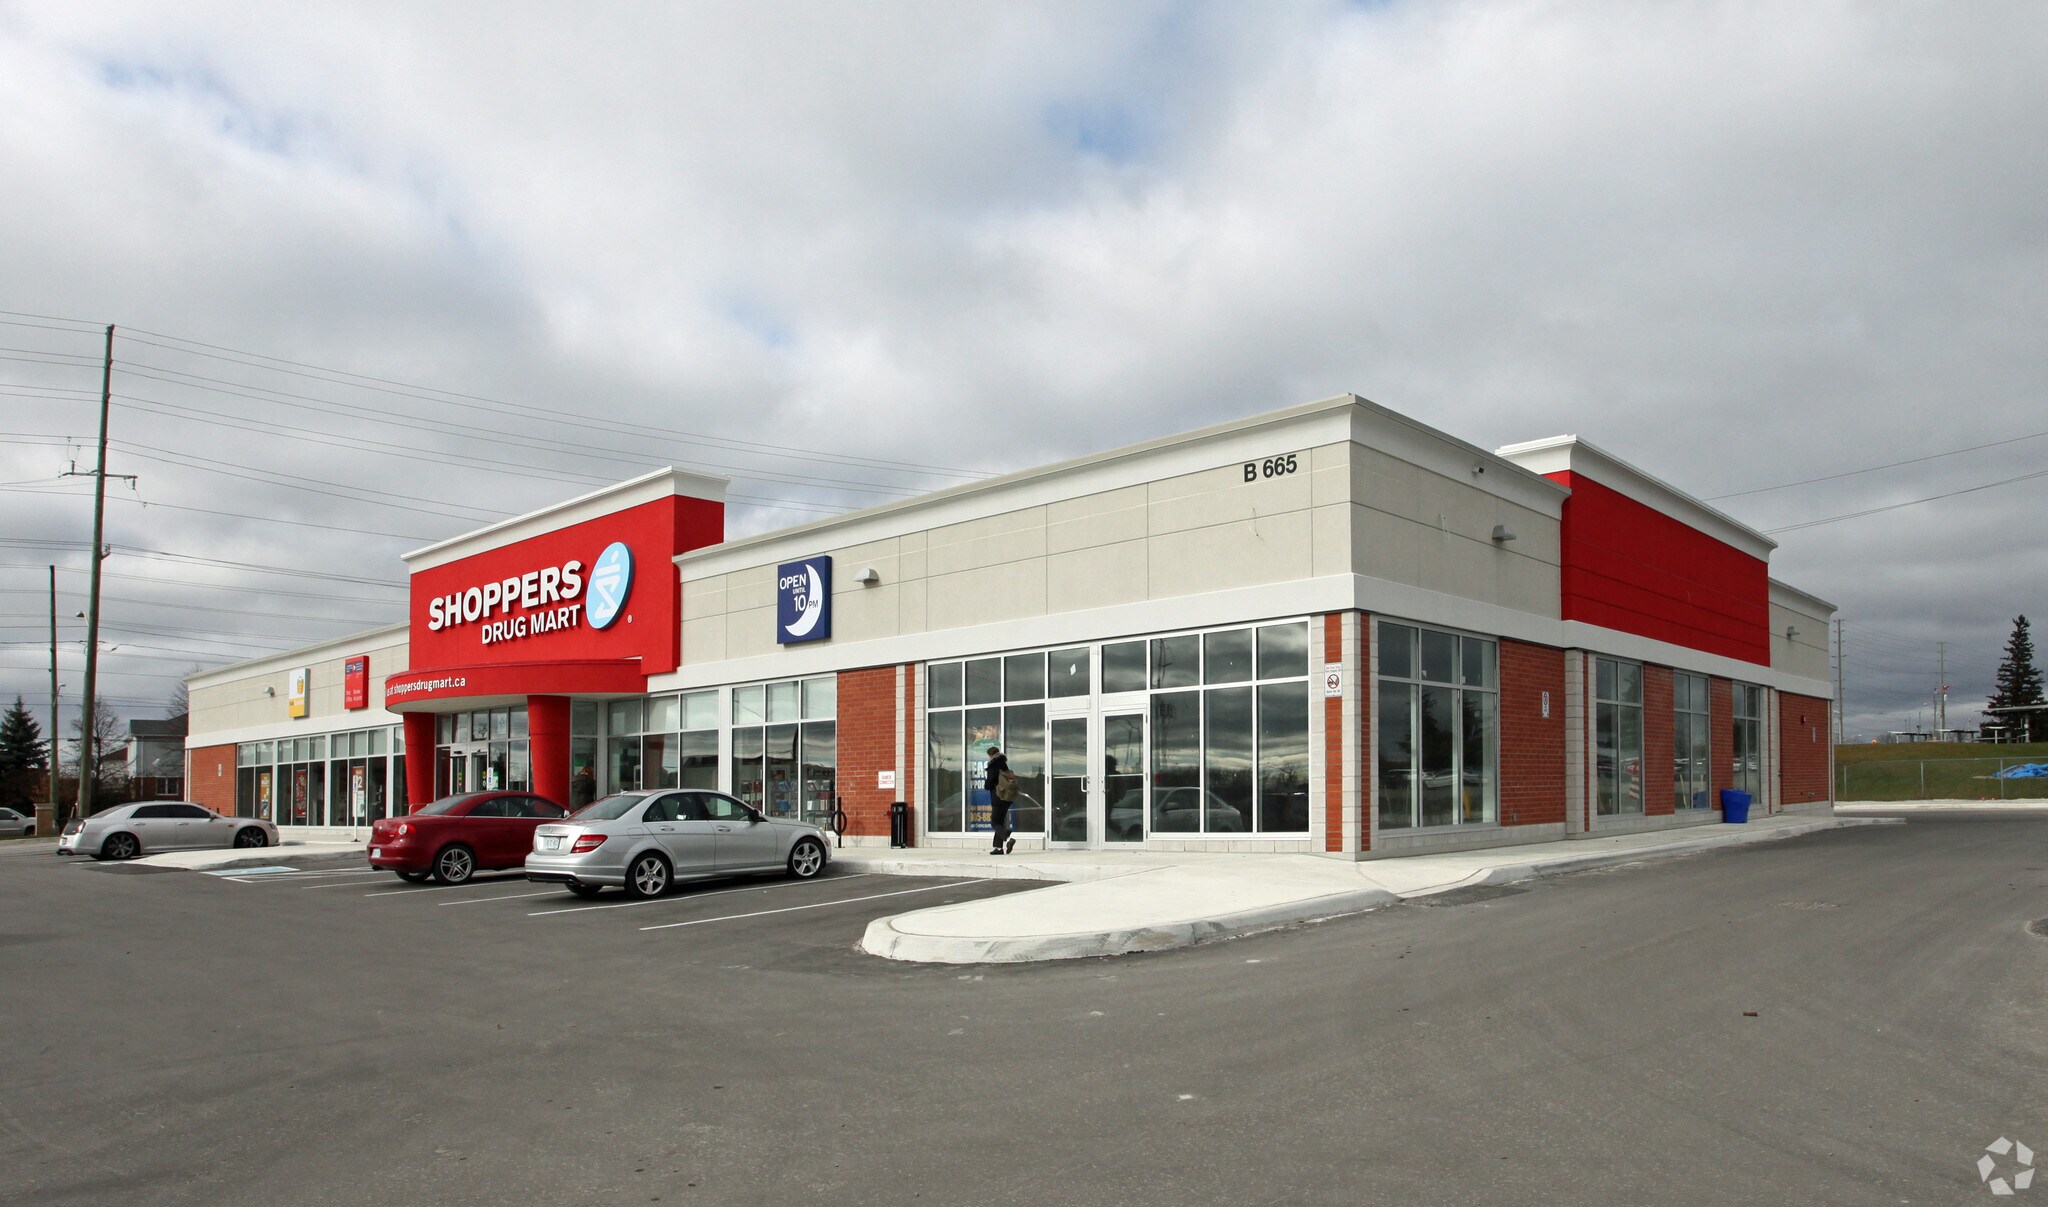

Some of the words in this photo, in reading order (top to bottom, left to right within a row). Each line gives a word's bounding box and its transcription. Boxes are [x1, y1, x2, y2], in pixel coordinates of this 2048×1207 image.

[1244, 463, 1257, 483] B
[1263, 454, 1297, 478] 665
[780, 573, 806, 590] OPEN
[428, 560, 582, 631] SHOPPERS
[794, 594, 806, 612] 10
[809, 600, 818, 609] PM
[481, 616, 526, 644] DRUG
[531, 604, 581, 634] MART
[393, 677, 466, 696] shoppersdrugmart.ca
